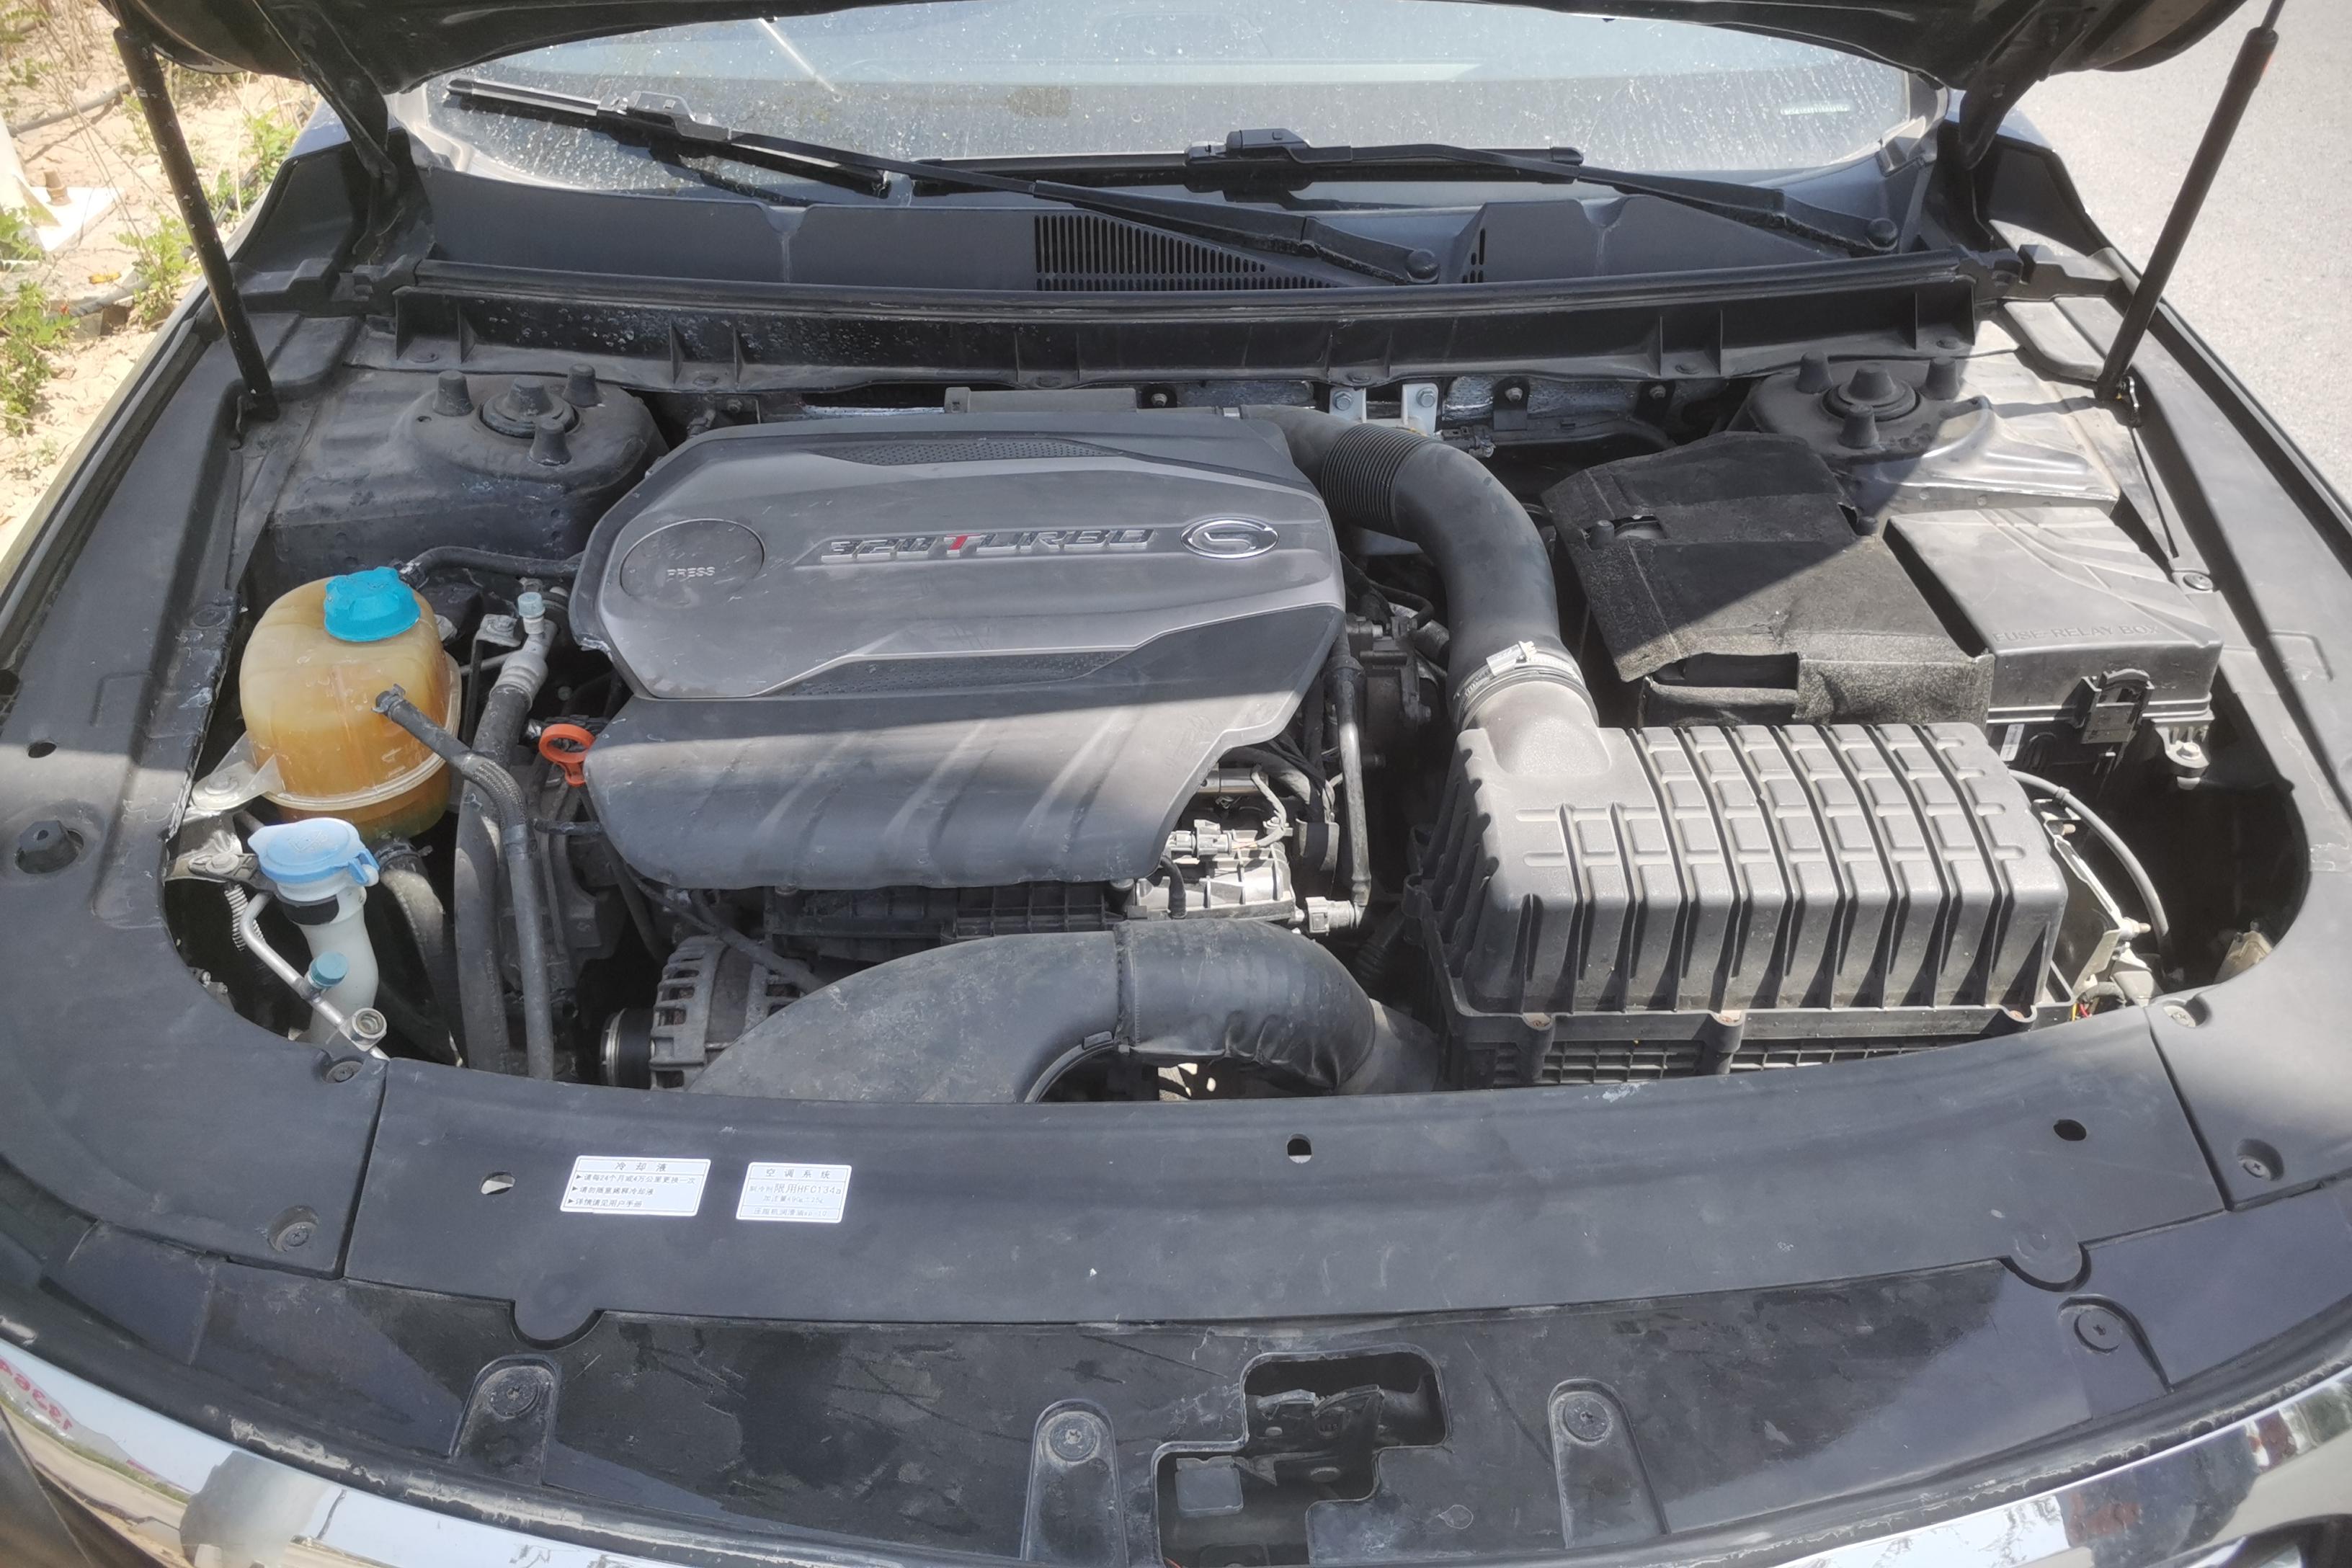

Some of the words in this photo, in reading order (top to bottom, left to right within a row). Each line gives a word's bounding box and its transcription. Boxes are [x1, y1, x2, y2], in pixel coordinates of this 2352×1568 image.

[667, 566, 715, 582] PRESS
[2119, 624, 2159, 635] BOX
[615, 1162, 668, 1172] 冷却液
[765, 1168, 831, 1180] 空调系统
